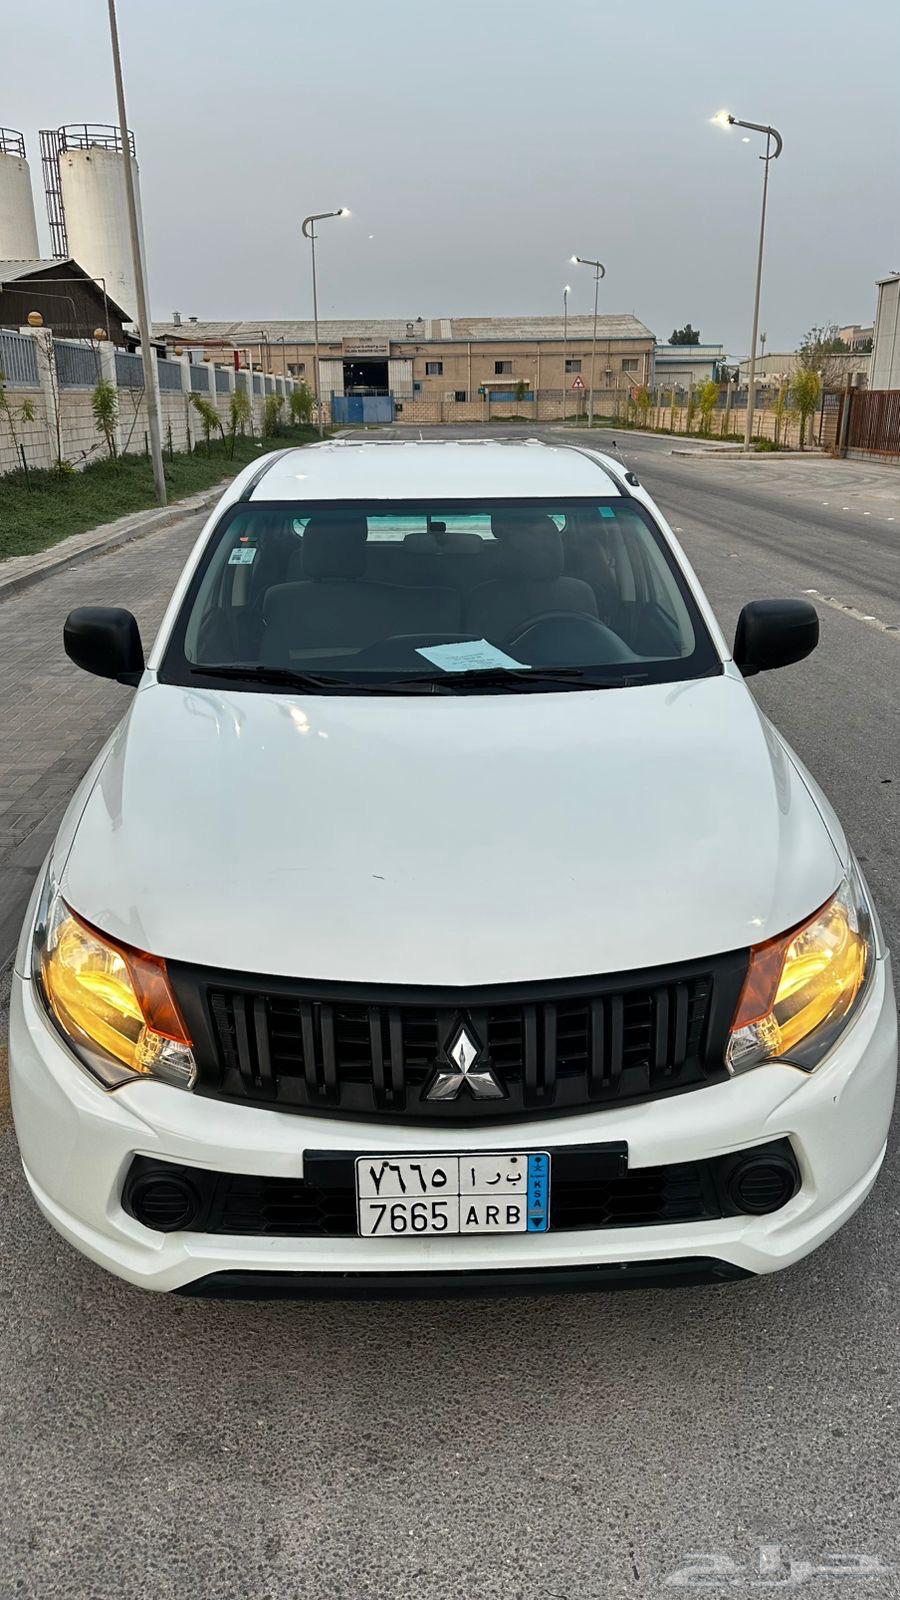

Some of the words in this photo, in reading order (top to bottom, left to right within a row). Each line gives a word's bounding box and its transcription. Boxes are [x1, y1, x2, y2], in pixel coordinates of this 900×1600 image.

[369, 1164, 447, 1195] ٧٦٦٥
[533, 1180, 542, 1208] KSA
[369, 1201, 448, 1234] 7665
[465, 1205, 521, 1225] ARB
